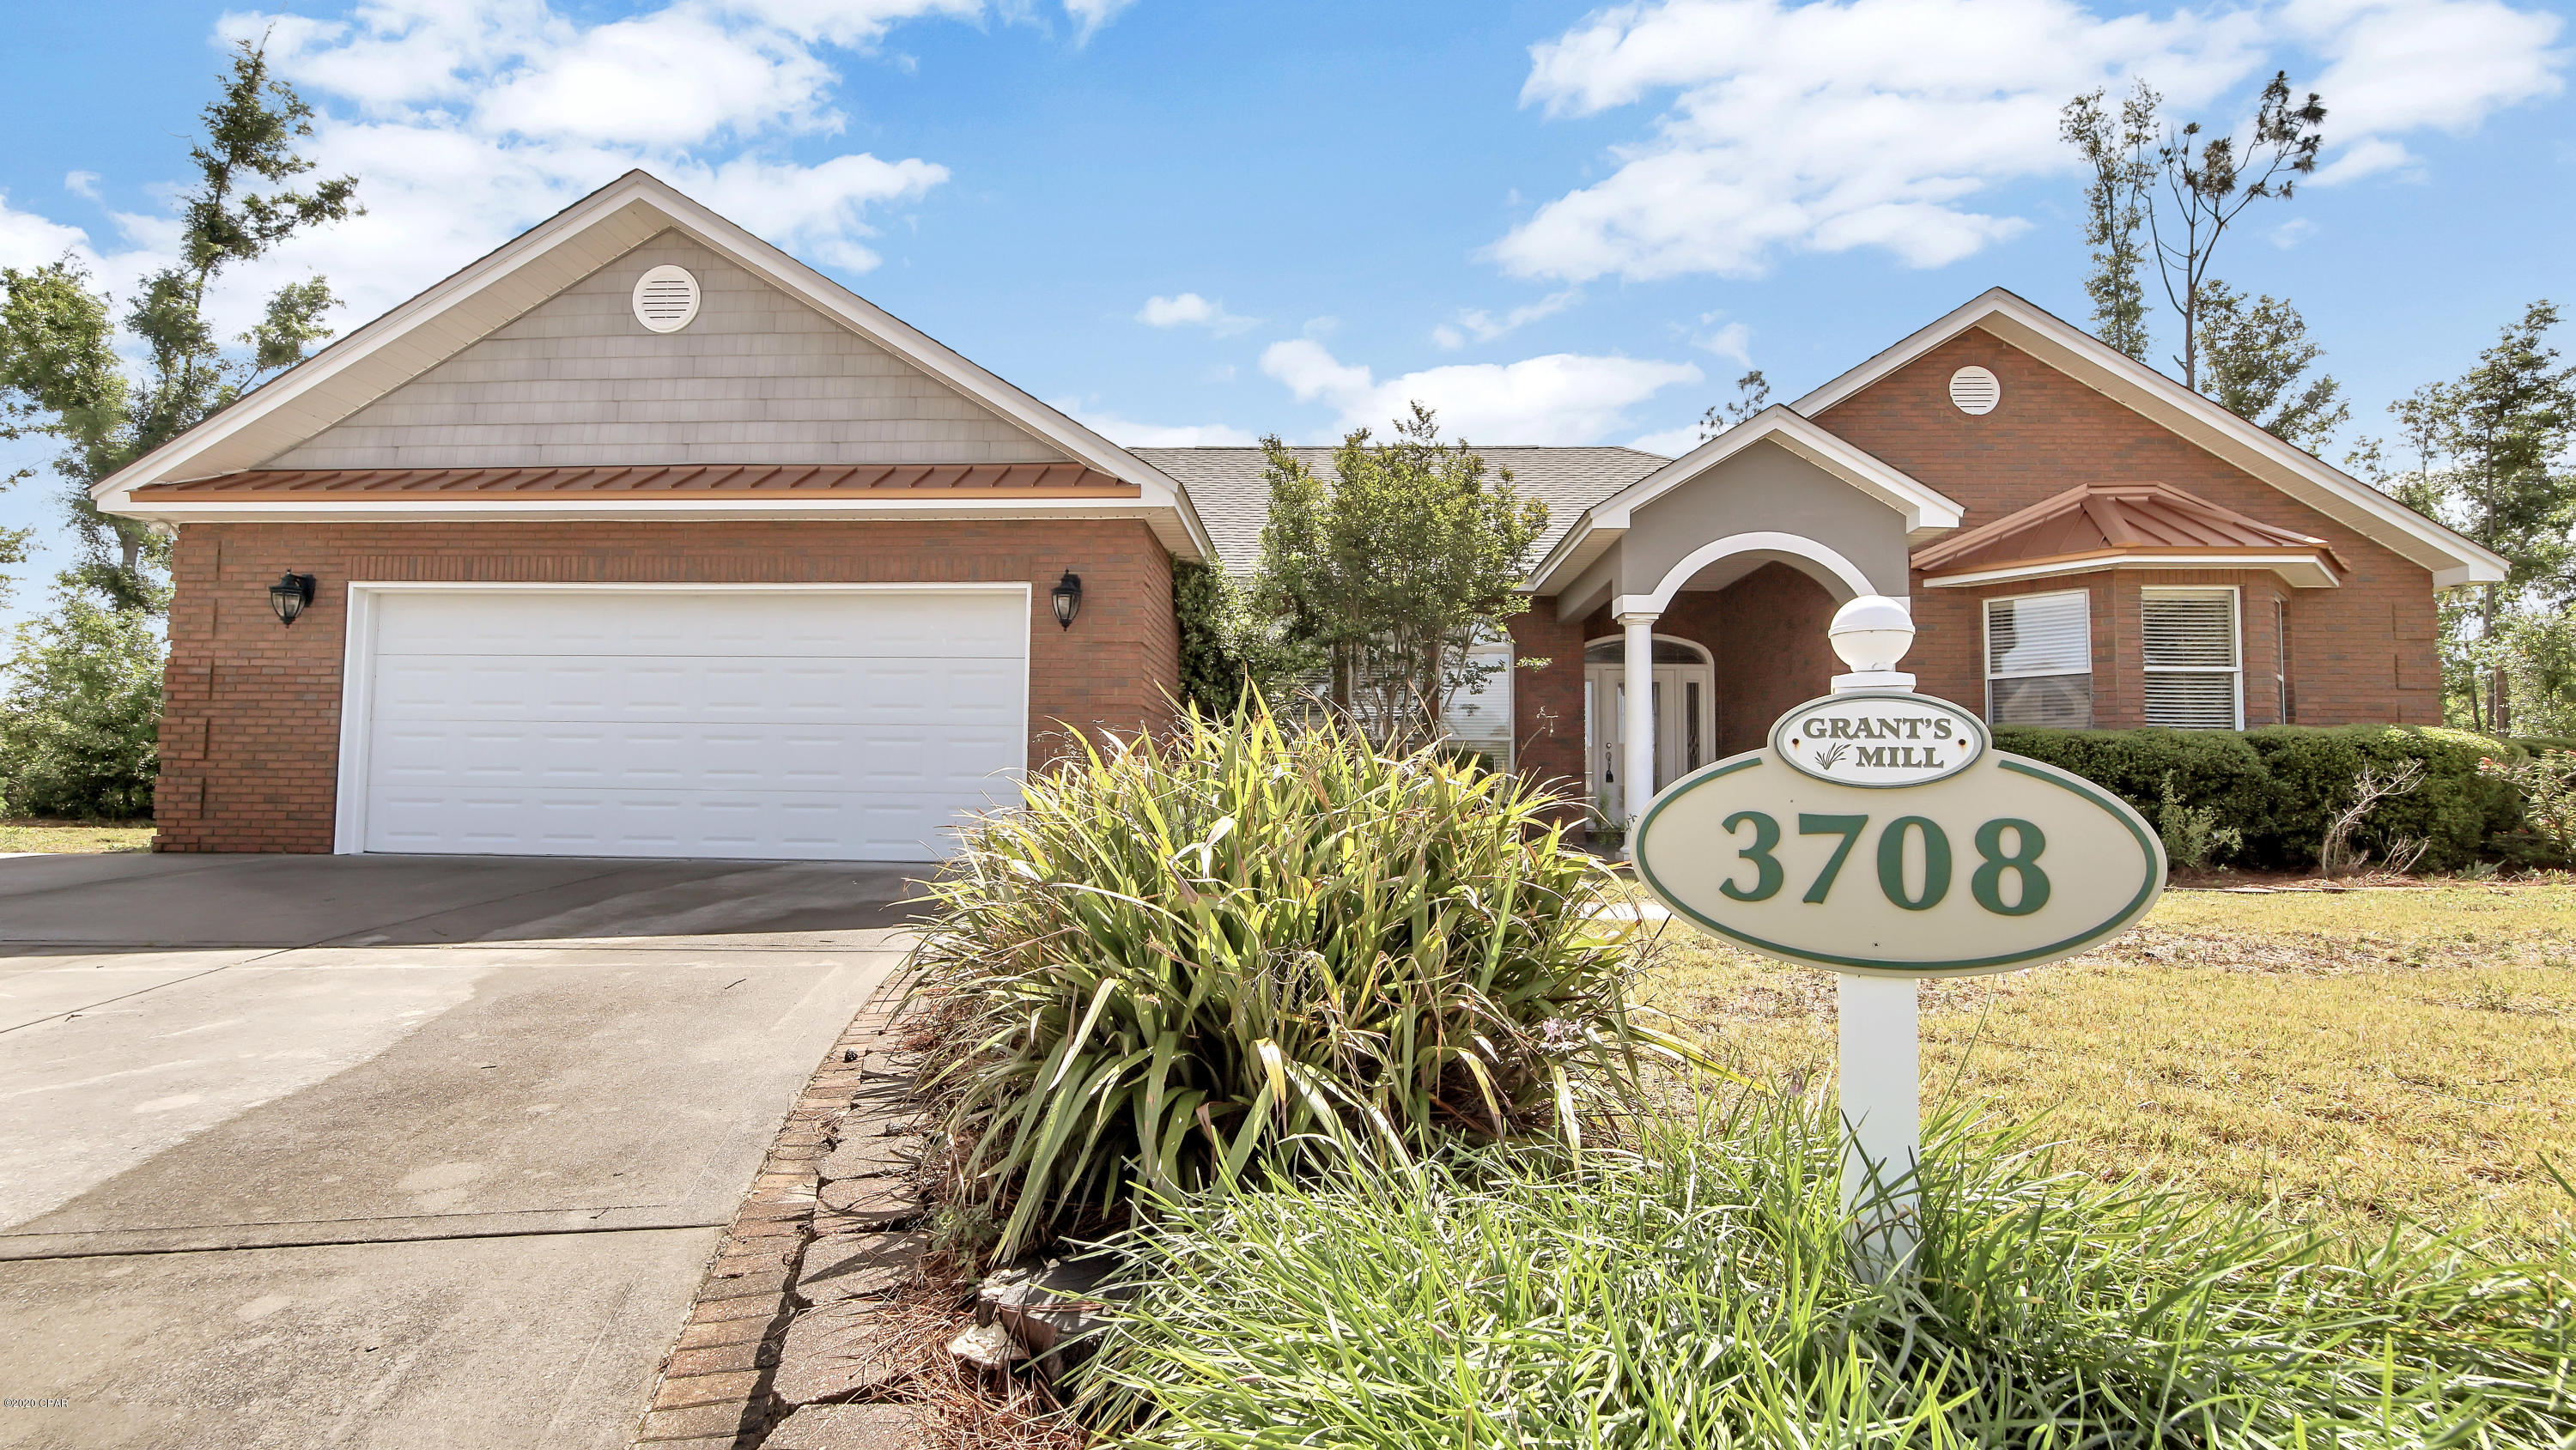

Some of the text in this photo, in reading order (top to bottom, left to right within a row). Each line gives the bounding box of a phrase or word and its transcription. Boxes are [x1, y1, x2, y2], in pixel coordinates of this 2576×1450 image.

[1802, 716, 1953, 741] GRANT'S
[1856, 746, 1945, 769] MILL
[1718, 810, 2051, 916] 3708
